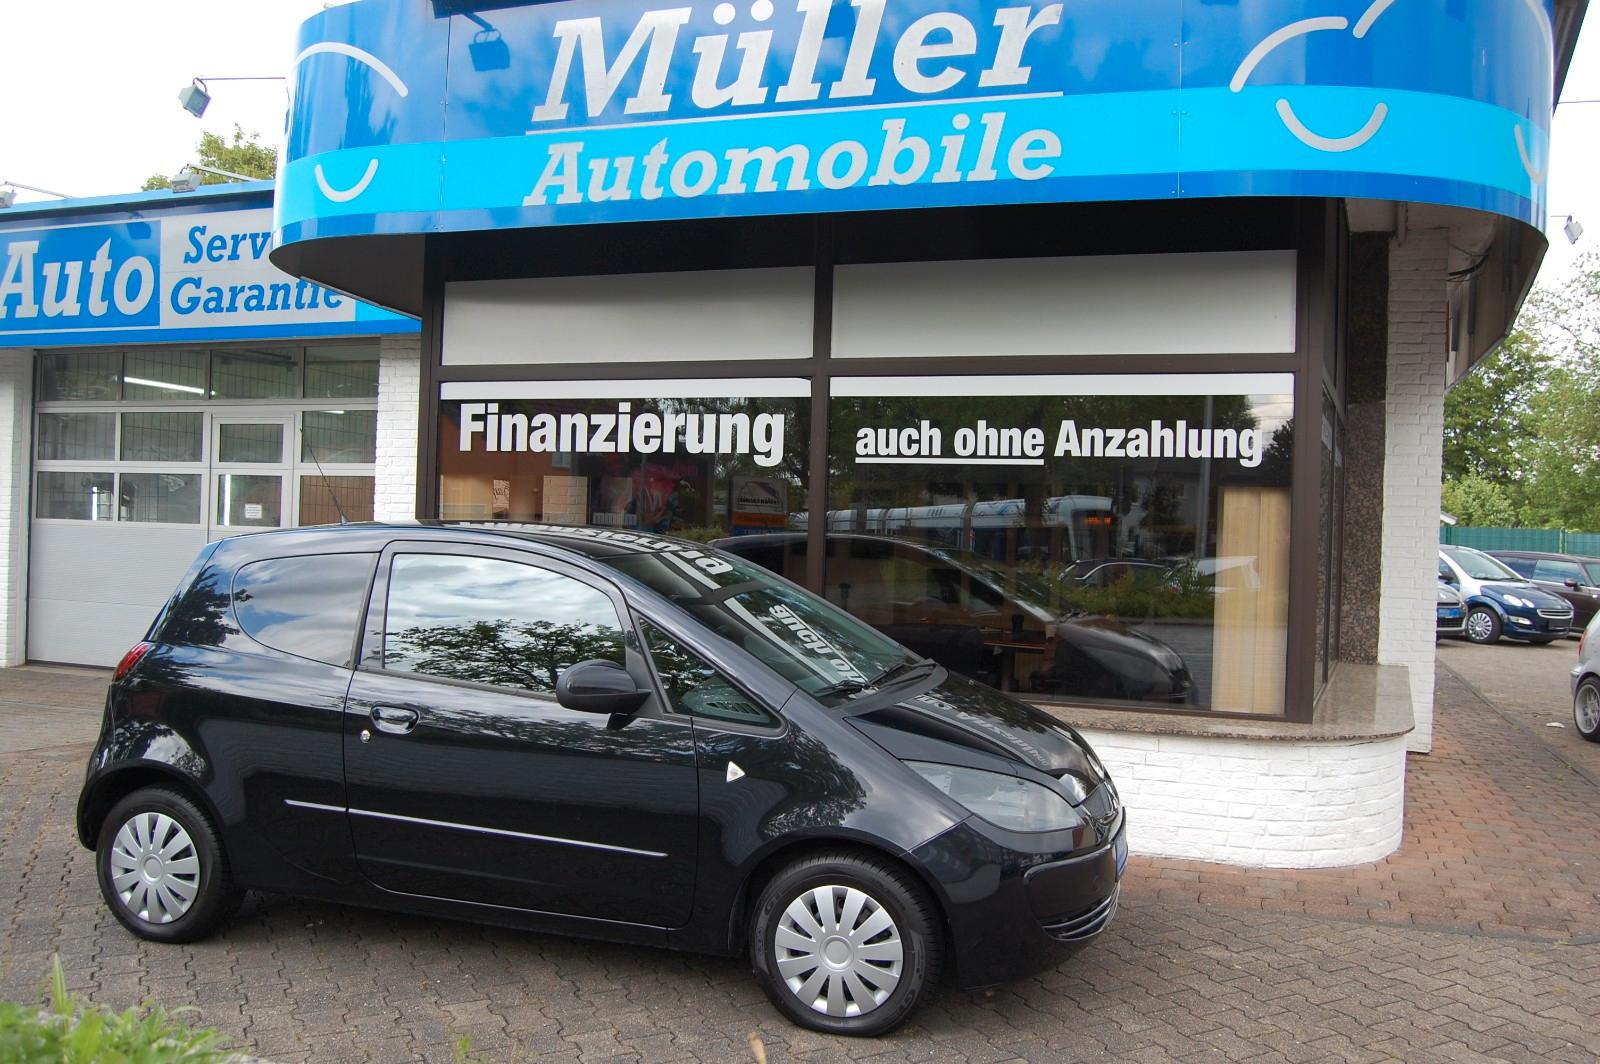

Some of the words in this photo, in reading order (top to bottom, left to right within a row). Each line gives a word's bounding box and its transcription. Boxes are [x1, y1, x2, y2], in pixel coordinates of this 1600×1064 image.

[531, 0, 1063, 122] Müller
[522, 112, 1062, 207] Automobile
[0, 237, 155, 319] Auto
[184, 225, 273, 264] Serv
[460, 402, 785, 467] Finanzierung
[855, 420, 941, 456] auch
[954, 420, 1045, 456] ohne
[1054, 420, 1263, 468] Anzahlung
